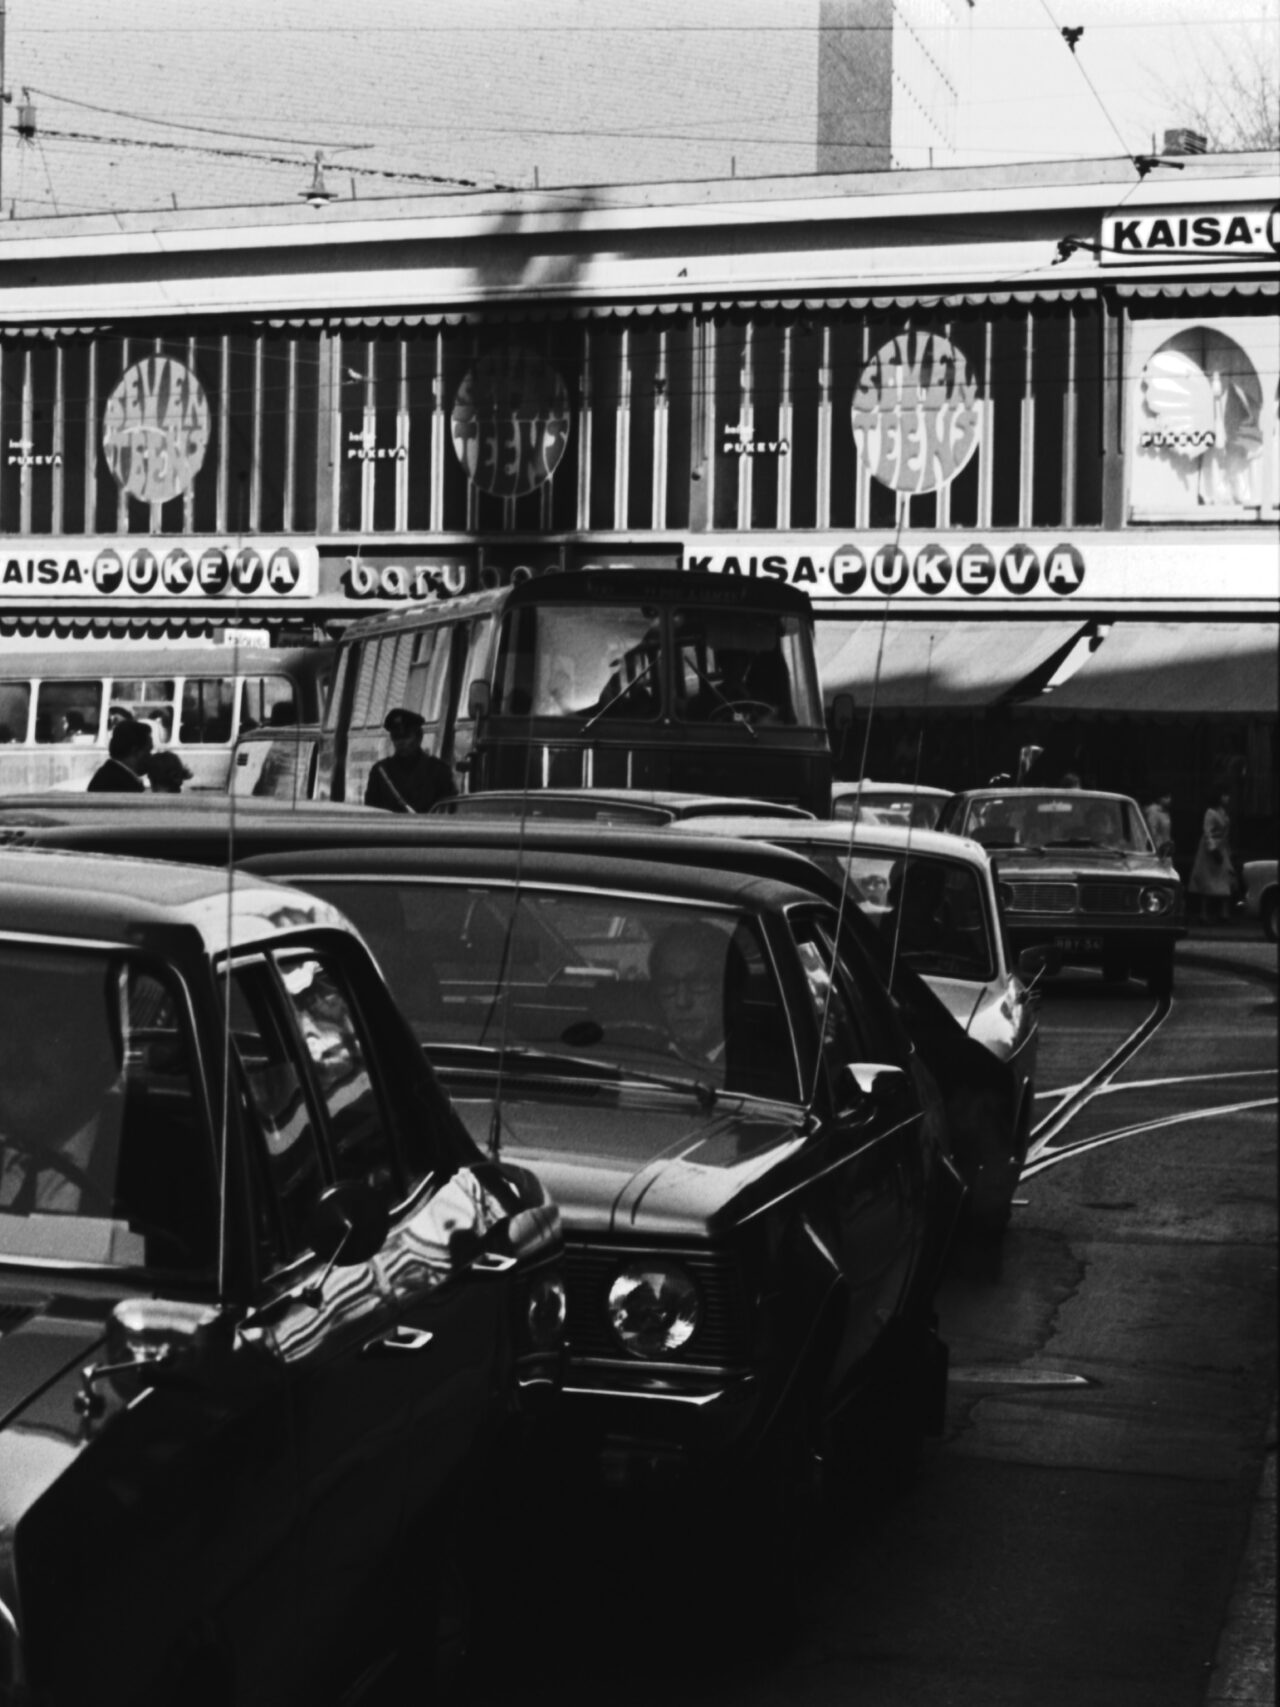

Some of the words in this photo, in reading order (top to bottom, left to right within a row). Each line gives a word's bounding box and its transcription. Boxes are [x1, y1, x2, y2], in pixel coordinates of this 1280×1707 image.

[1140, 431, 1216, 448] PUKEVA
[723, 442, 789, 453] PUKEVA
[347, 448, 408, 459] PUKEVA
[8, 455, 63, 466] PUKEVA
